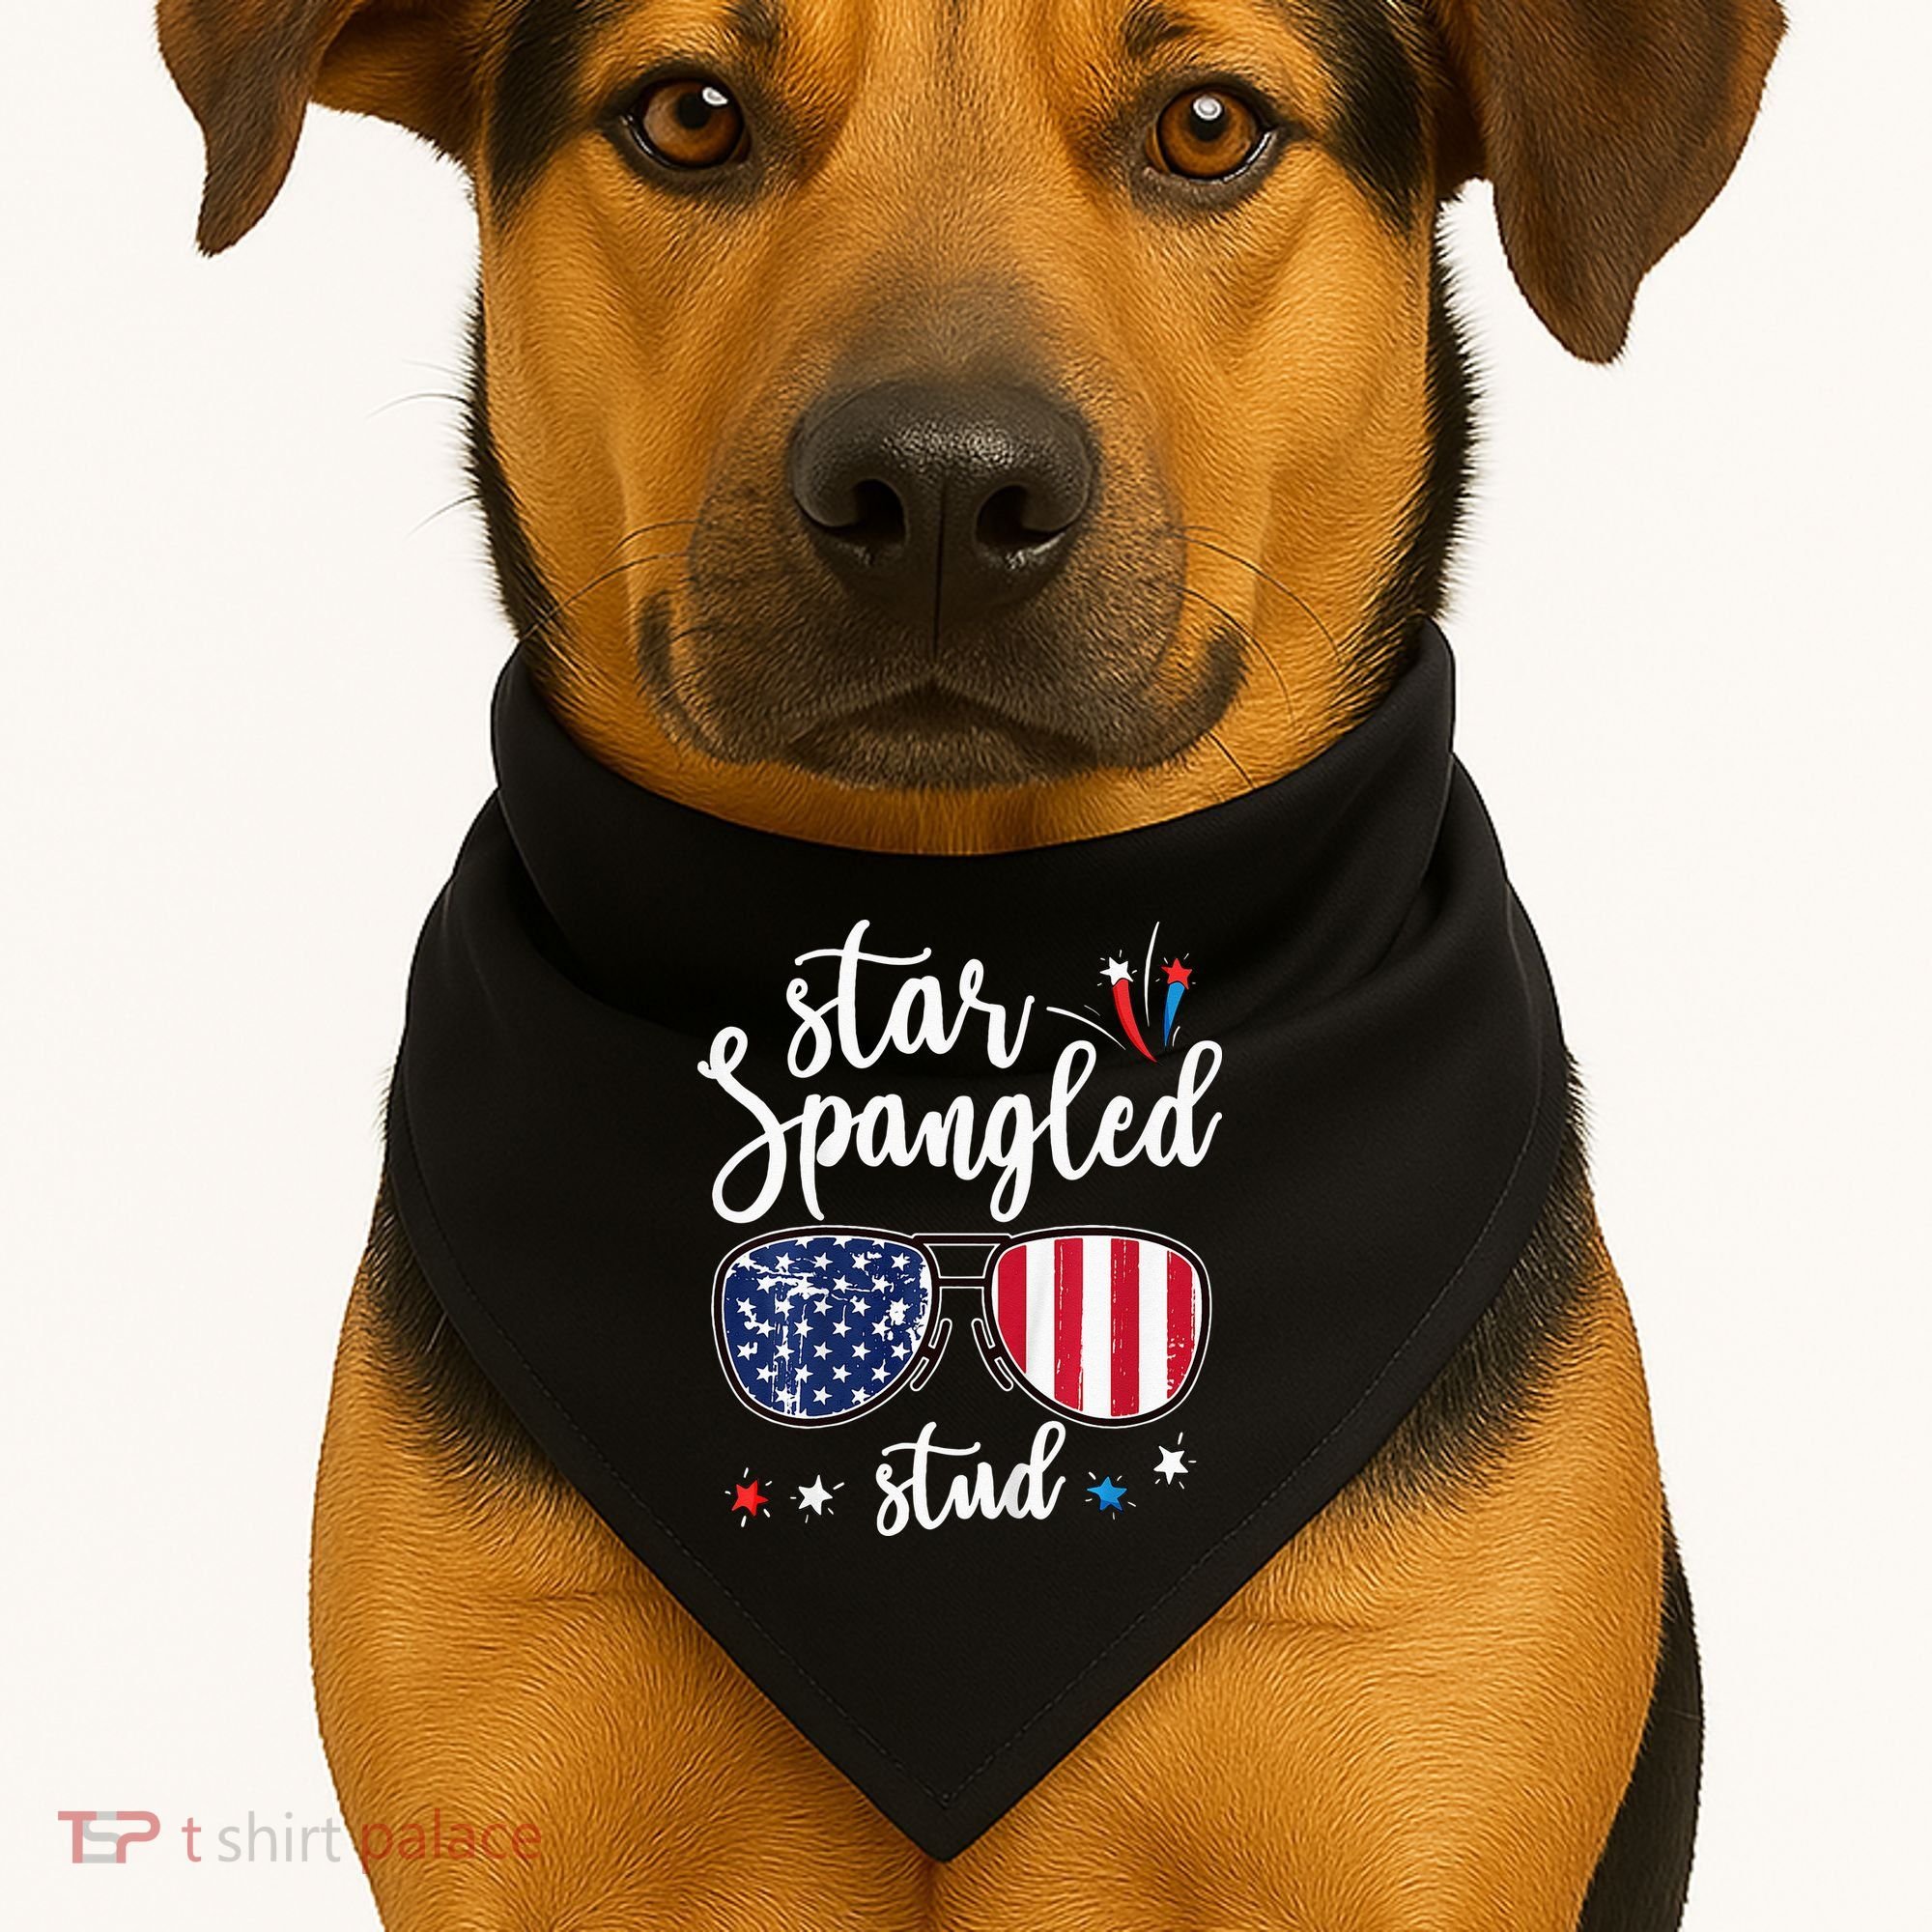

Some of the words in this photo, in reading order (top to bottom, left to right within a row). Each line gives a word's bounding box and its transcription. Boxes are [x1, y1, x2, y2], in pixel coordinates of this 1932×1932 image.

[785, 919, 1036, 1079] star
[696, 1026, 1223, 1224] Spangled
[875, 1420, 1066, 1537] stud
